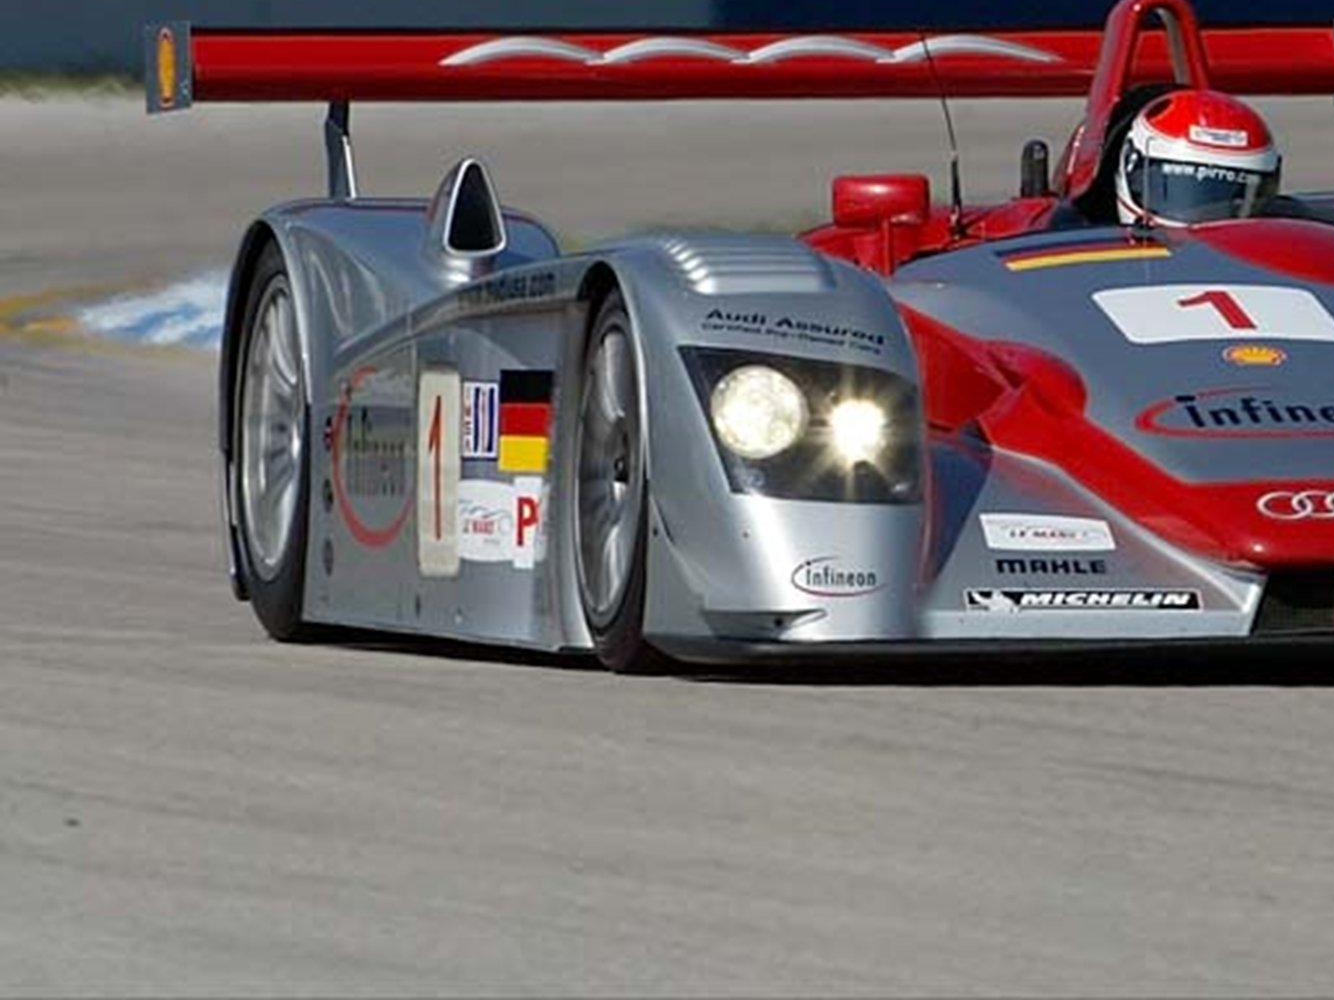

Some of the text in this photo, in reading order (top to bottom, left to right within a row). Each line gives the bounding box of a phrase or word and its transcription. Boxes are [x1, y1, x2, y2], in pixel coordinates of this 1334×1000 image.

[705, 308, 766, 325] Audi
[1176, 290, 1258, 330] 1
[428, 395, 442, 541] 1
[995, 558, 1107, 575] MAHLE
[1020, 592, 1190, 606] MICHELIN
